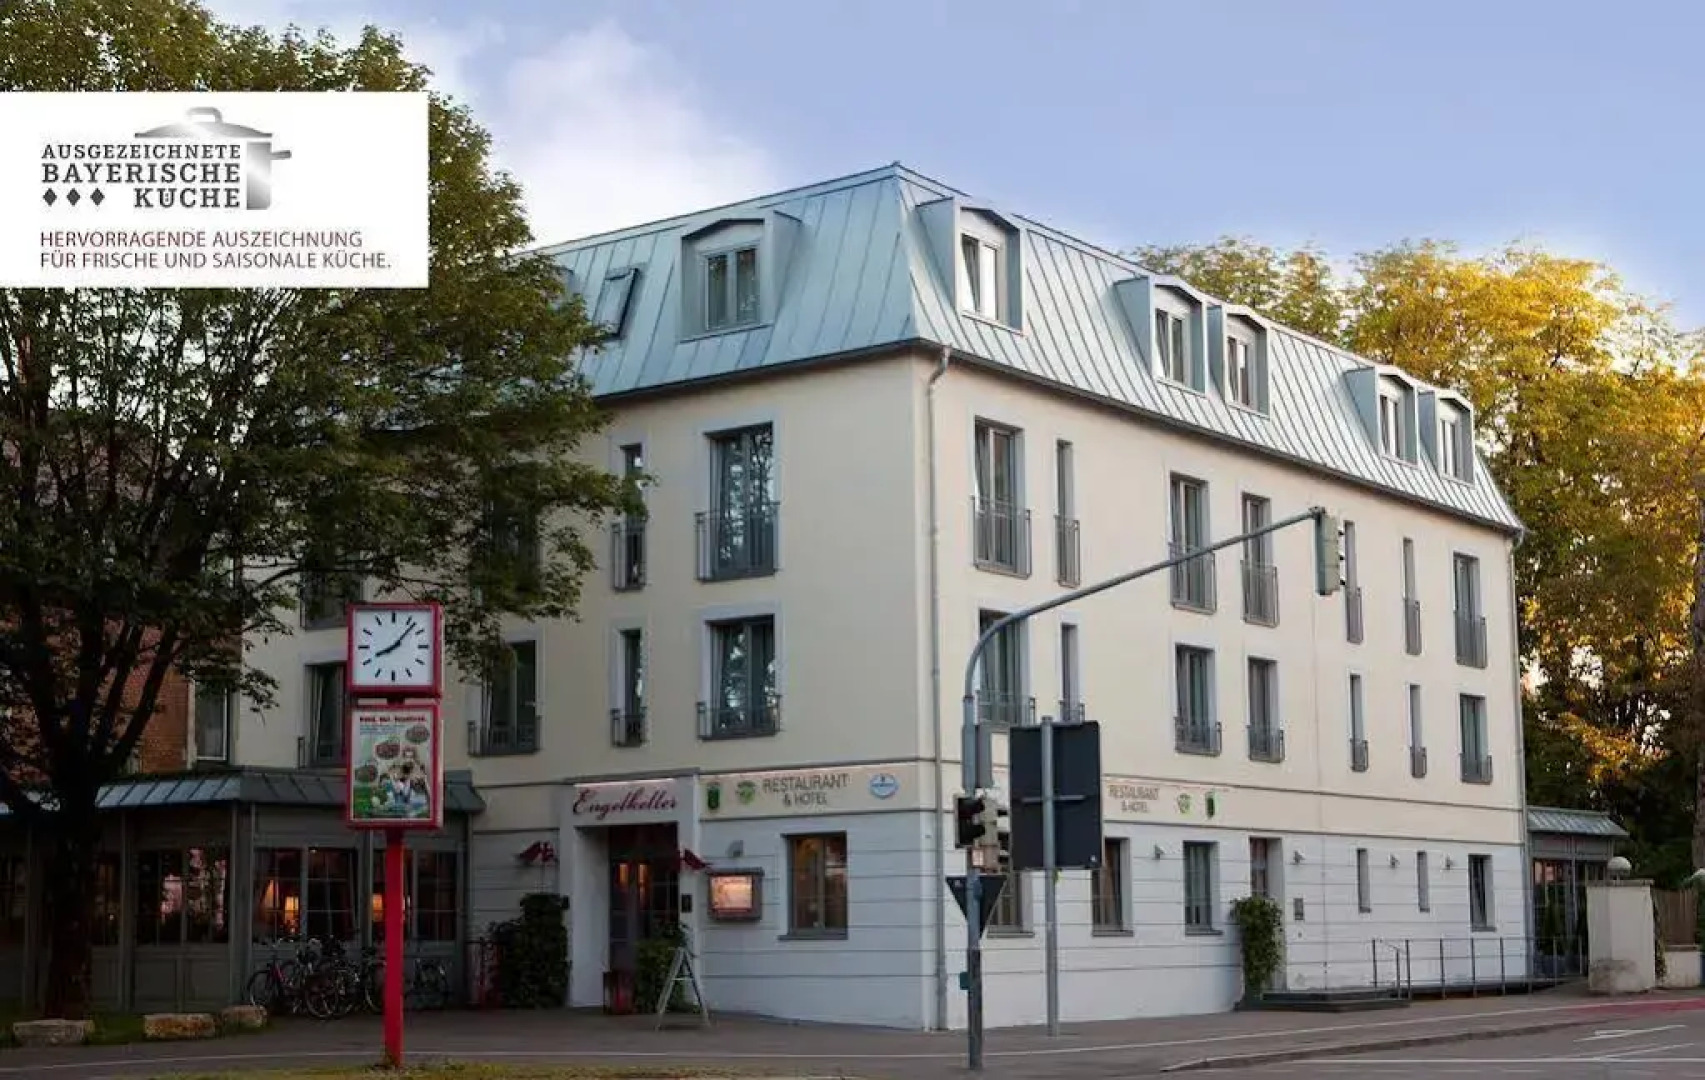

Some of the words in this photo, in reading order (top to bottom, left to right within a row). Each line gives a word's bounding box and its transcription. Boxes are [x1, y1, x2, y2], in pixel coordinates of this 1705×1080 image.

[762, 773, 848, 793] RESTAURANT
[573, 787, 677, 820] Engelkeller
[794, 791, 827, 806] HOTEL
